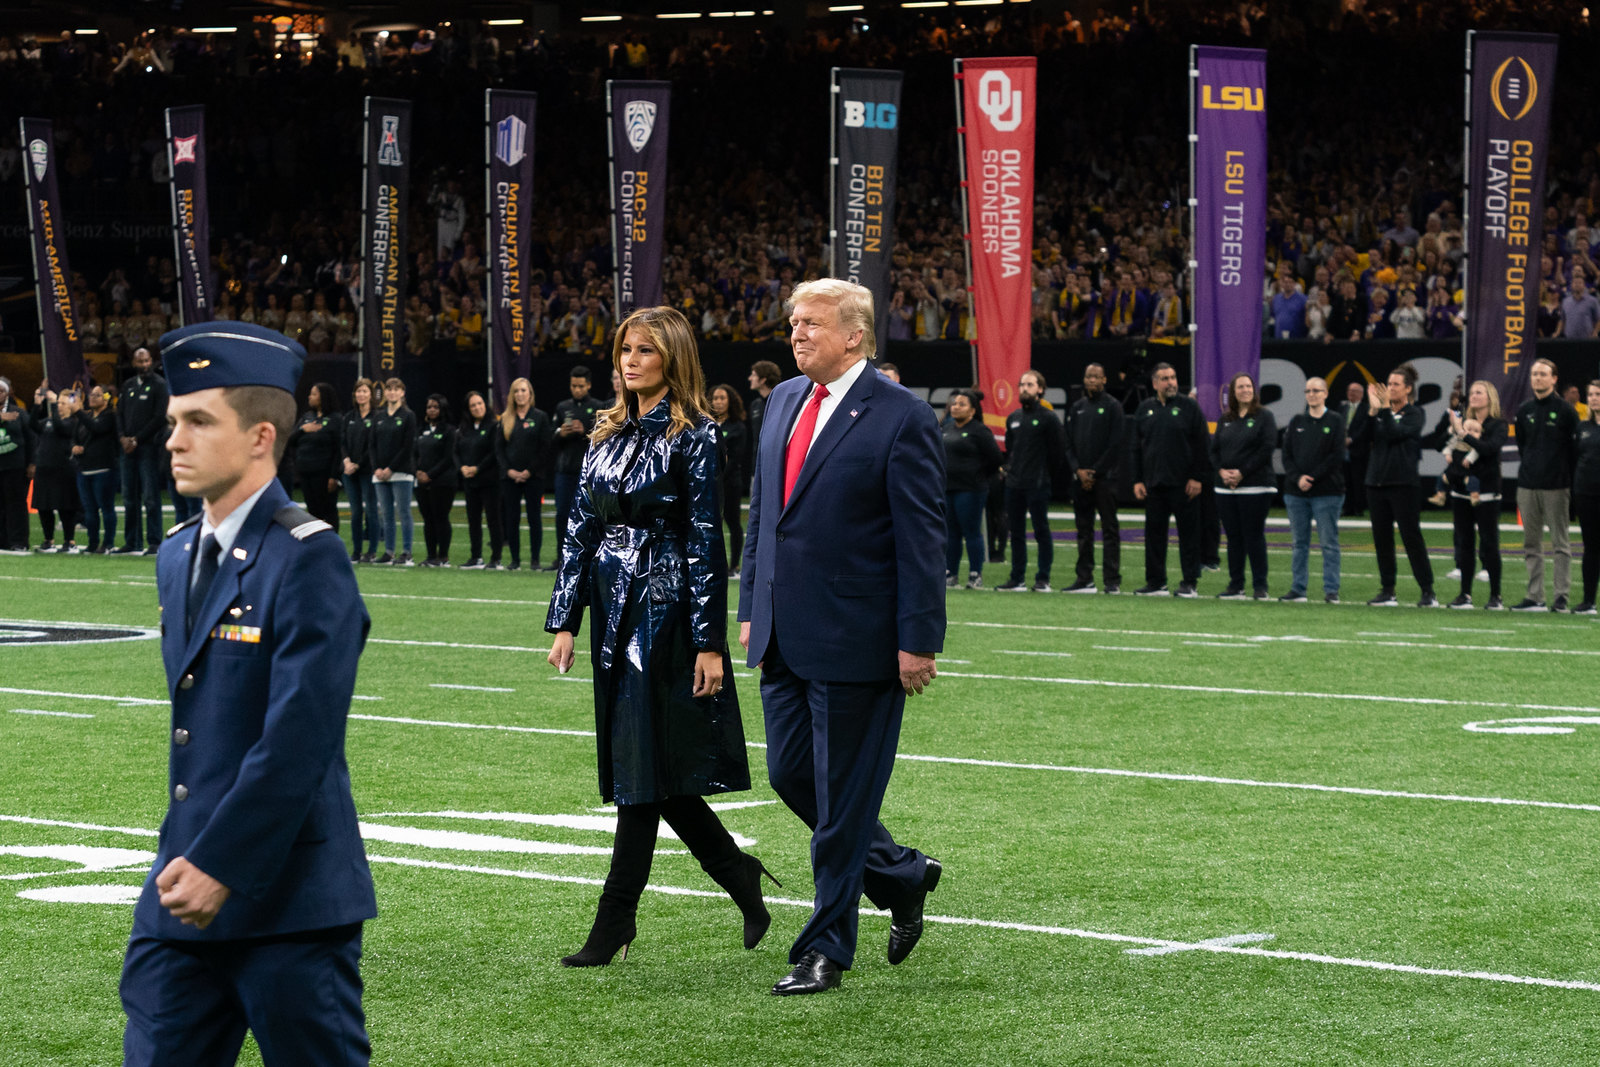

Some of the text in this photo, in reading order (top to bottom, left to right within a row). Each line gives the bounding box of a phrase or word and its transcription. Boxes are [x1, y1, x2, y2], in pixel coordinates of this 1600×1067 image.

[1202, 84, 1266, 112] LSU
[507, 182, 520, 294] MOUNTAIN
[620, 170, 638, 303] CONFERENCE
[631, 170, 649, 243] PAC-12
[845, 163, 865, 284] CONFERENC
[863, 165, 885, 253] BIG TEN
[981, 148, 1000, 254] SOONERS
[999, 148, 1022, 279] OKLAHOMA
[1219, 149, 1245, 287] LSU TIGERS
[1484, 138, 1511, 240] PLAYOFF
[381, 185, 401, 371] AMERICAN ATHLETIC
[1502, 139, 1534, 375] COLLEGE FOOTBALL
[510, 297, 526, 357] WEST
